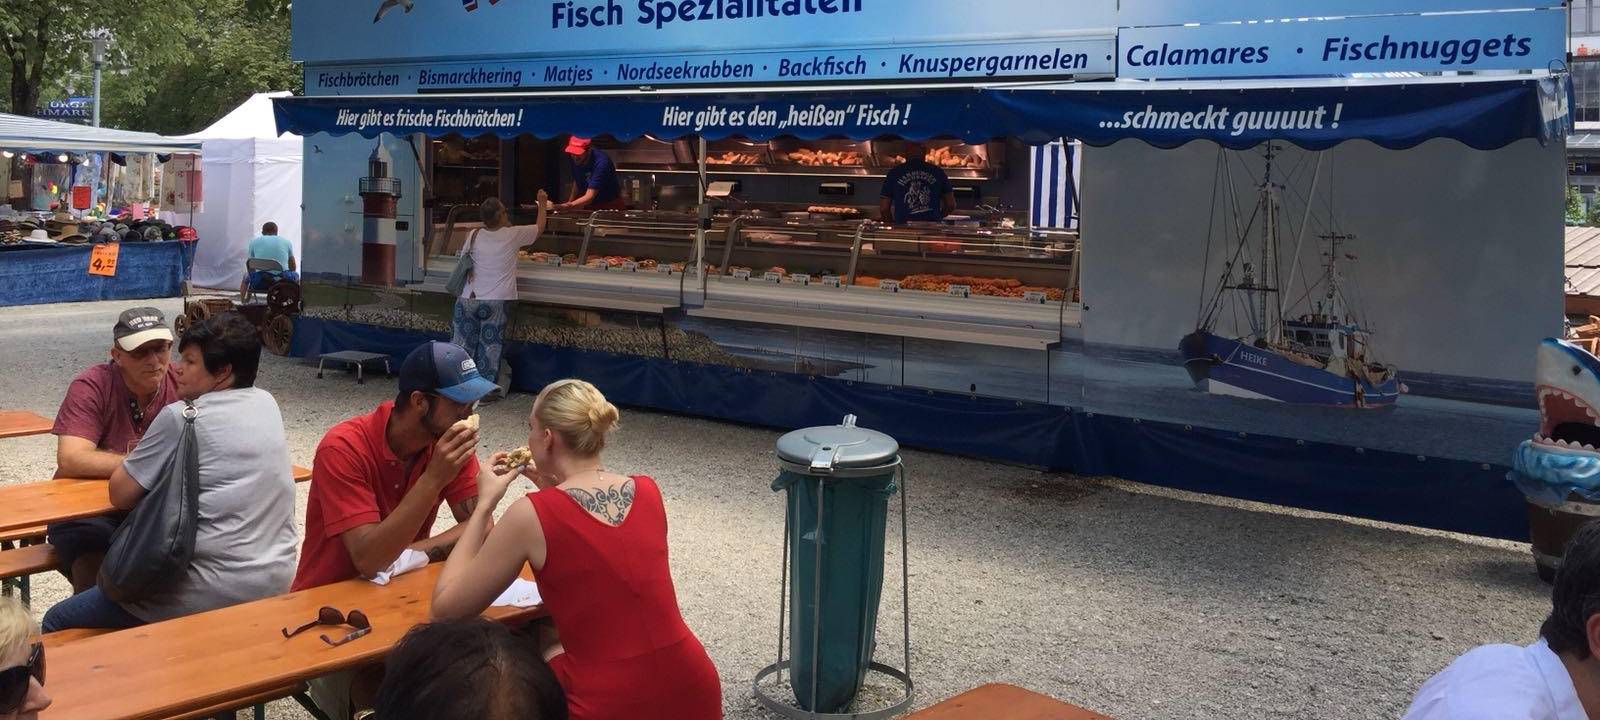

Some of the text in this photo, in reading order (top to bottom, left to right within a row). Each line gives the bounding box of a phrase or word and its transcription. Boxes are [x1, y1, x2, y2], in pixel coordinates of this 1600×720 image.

[552, 0, 623, 29] Fisch
[1125, 33, 1532, 68] Calamares Fischnuggets
[318, 48, 1089, 88] Fischbrötchen Bismarckhering Matjes Nordseekrabben Backfisch Knuspergarnelen
[336, 109, 359, 126] Hier
[359, 109, 383, 130] gibt
[383, 112, 394, 127] es
[396, 109, 433, 127] frische
[662, 106, 693, 126] Hier
[694, 106, 727, 131] gibt
[728, 109, 745, 127] es
[747, 105, 778, 127] den
[1240, 351, 1267, 366] HEIKE
